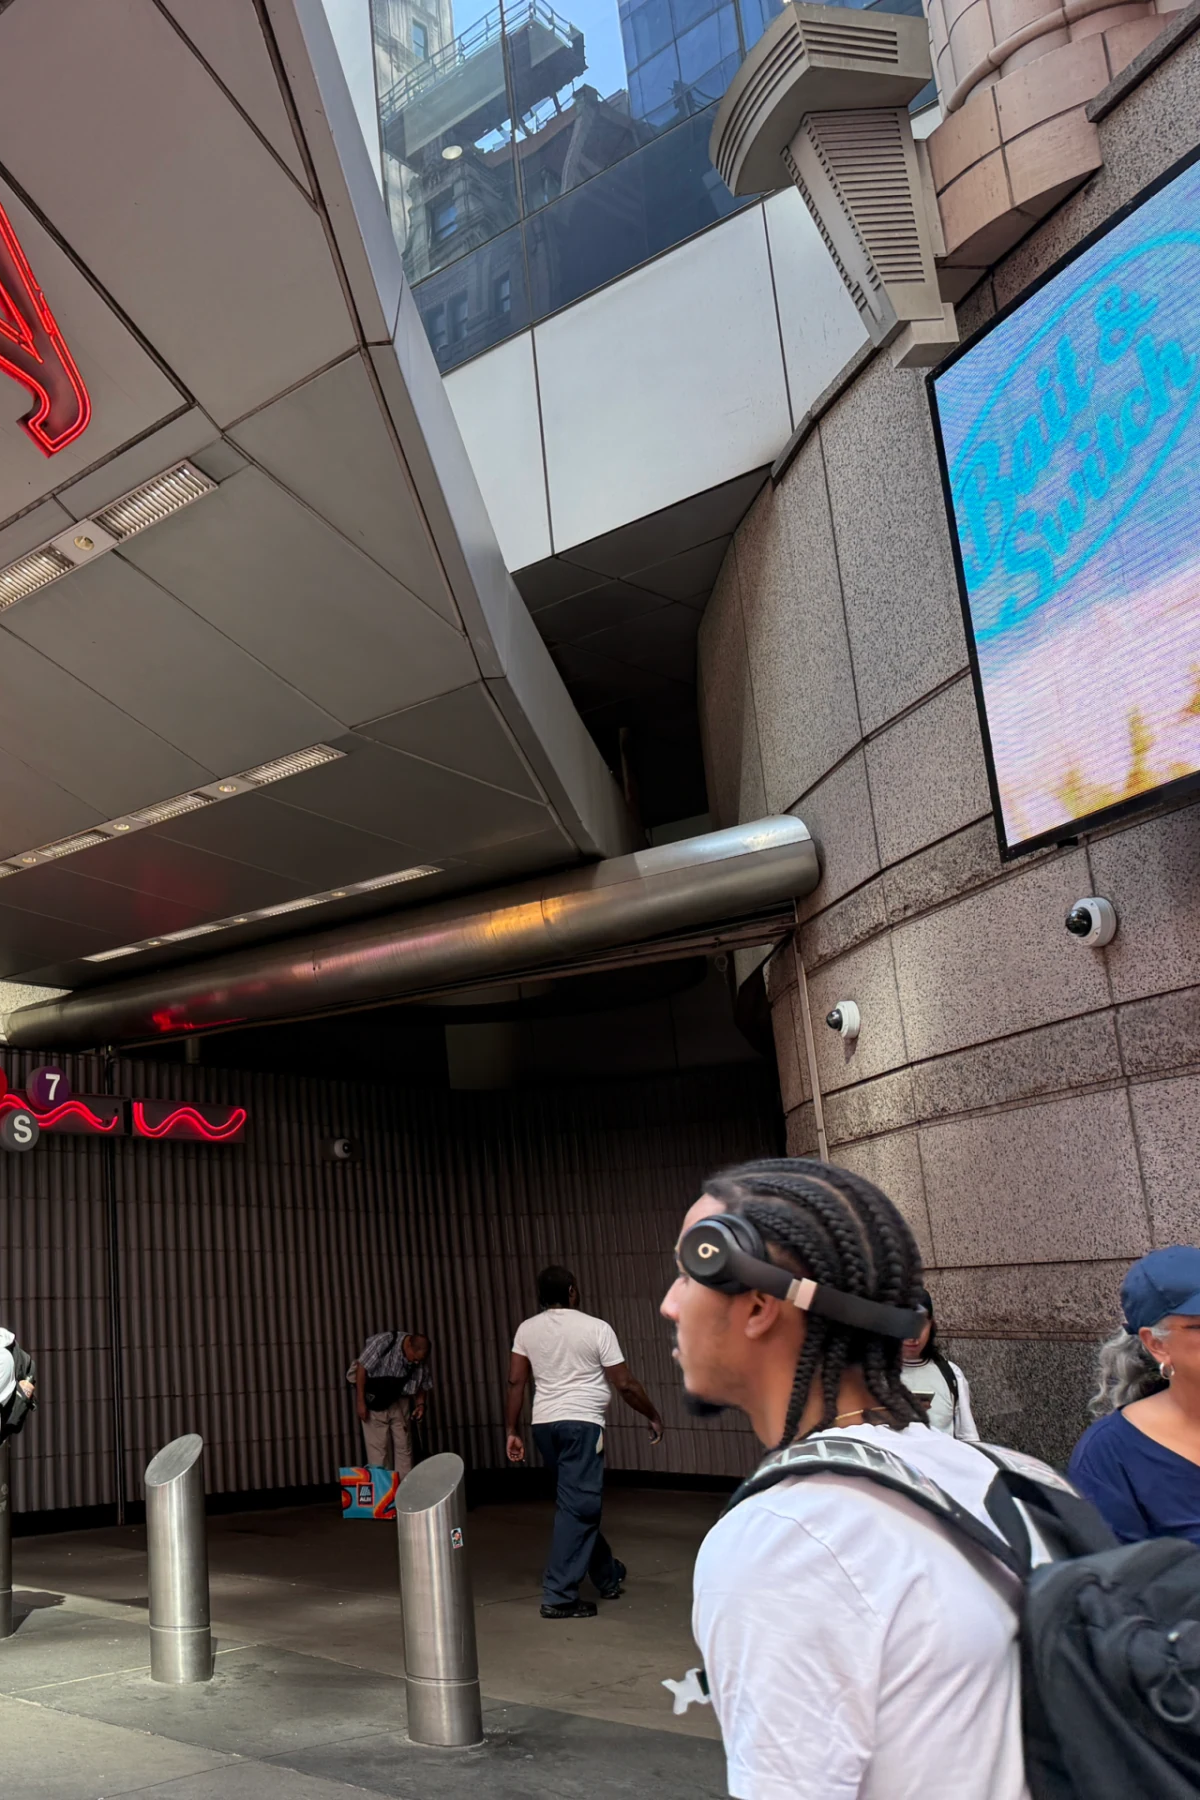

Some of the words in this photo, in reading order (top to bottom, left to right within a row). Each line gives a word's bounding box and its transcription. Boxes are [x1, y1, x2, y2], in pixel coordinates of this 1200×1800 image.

[956, 334, 1095, 592] Bait
[1094, 284, 1158, 365] &
[1000, 333, 1199, 628] Switch
[13, 1114, 33, 1143] S
[45, 1073, 61, 1101] 7
